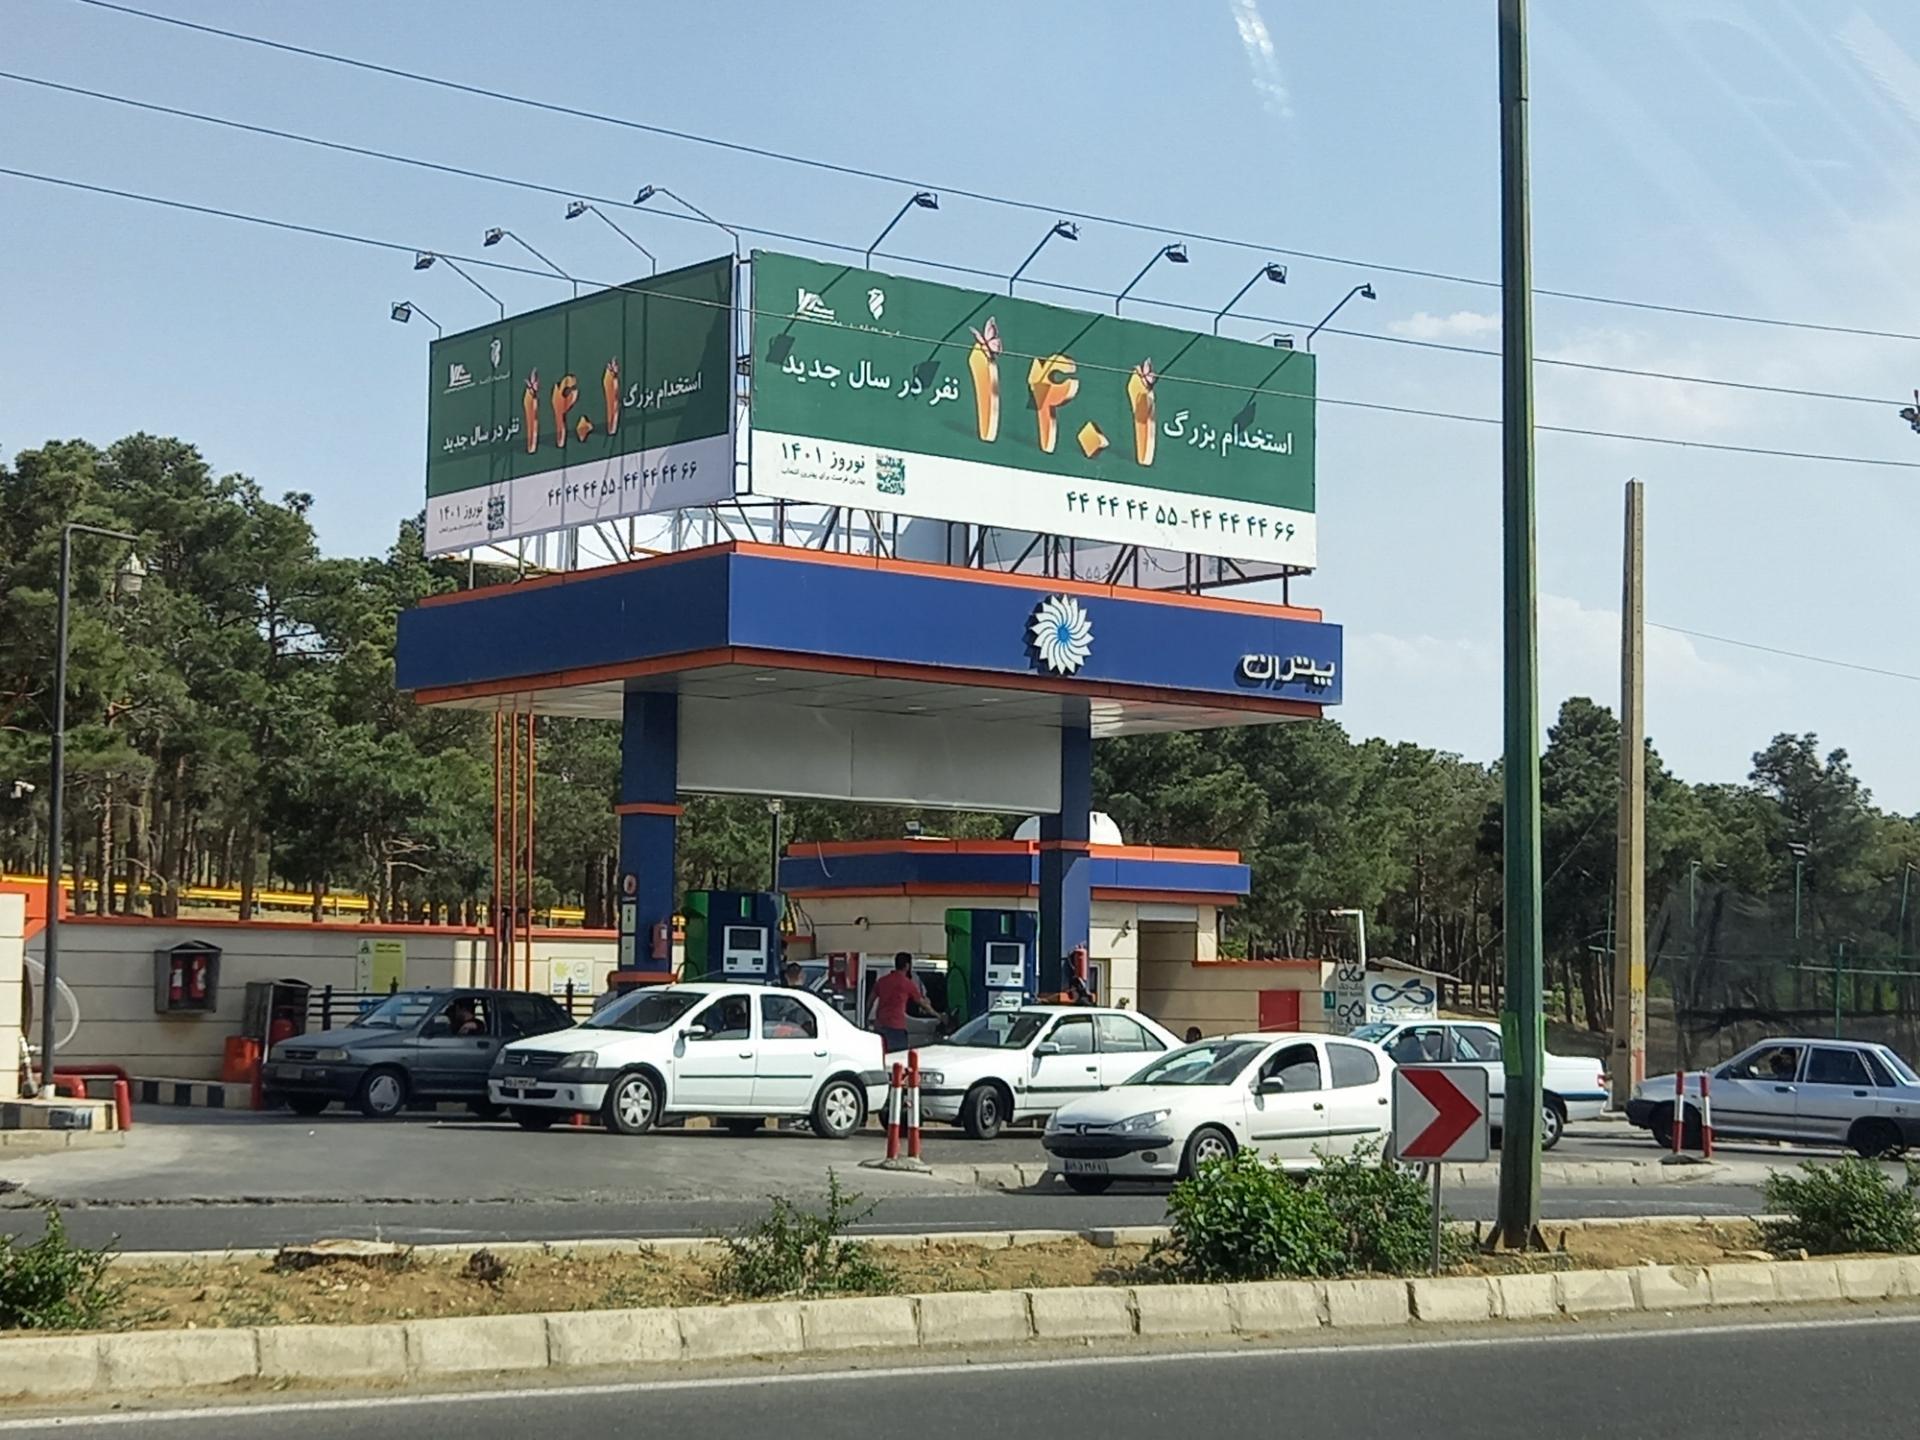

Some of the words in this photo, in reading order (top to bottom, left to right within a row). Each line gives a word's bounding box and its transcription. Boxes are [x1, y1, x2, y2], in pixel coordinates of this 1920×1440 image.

[782, 355, 841, 388] جدید
[849, 360, 890, 389] سال
[623, 384, 654, 408] بزرگ
[656, 372, 702, 409] استخدام
[898, 376, 923, 397] در
[929, 378, 959, 406] نفر
[470, 425, 490, 447] سال
[503, 417, 520, 442] نفر
[1163, 410, 1216, 449] بزرگ
[1221, 423, 1293, 456] استخدام
[443, 434, 468, 453] جدید
[781, 443, 822, 463] ۱۴۰۱
[830, 452, 866, 473] نوروز
[548, 487, 561, 507] ۴۴
[565, 483, 579, 502] ۴۴
[583, 480, 597, 499] ۴۴
[642, 467, 658, 487] ۴۴
[662, 463, 677, 483] ۴۴
[681, 460, 697, 479] ۶۶
[438, 504, 460, 522] ۱۴۰۱
[463, 500, 483, 520] نوروز
[1066, 491, 1090, 513] ۴۴
[1096, 495, 1120, 517] ۴۴
[1126, 498, 1149, 521] ۴۴
[1219, 512, 1240, 534] ۴۴
[1247, 516, 1268, 537] ۴۴
[1273, 521, 1296, 542] ۶۶
